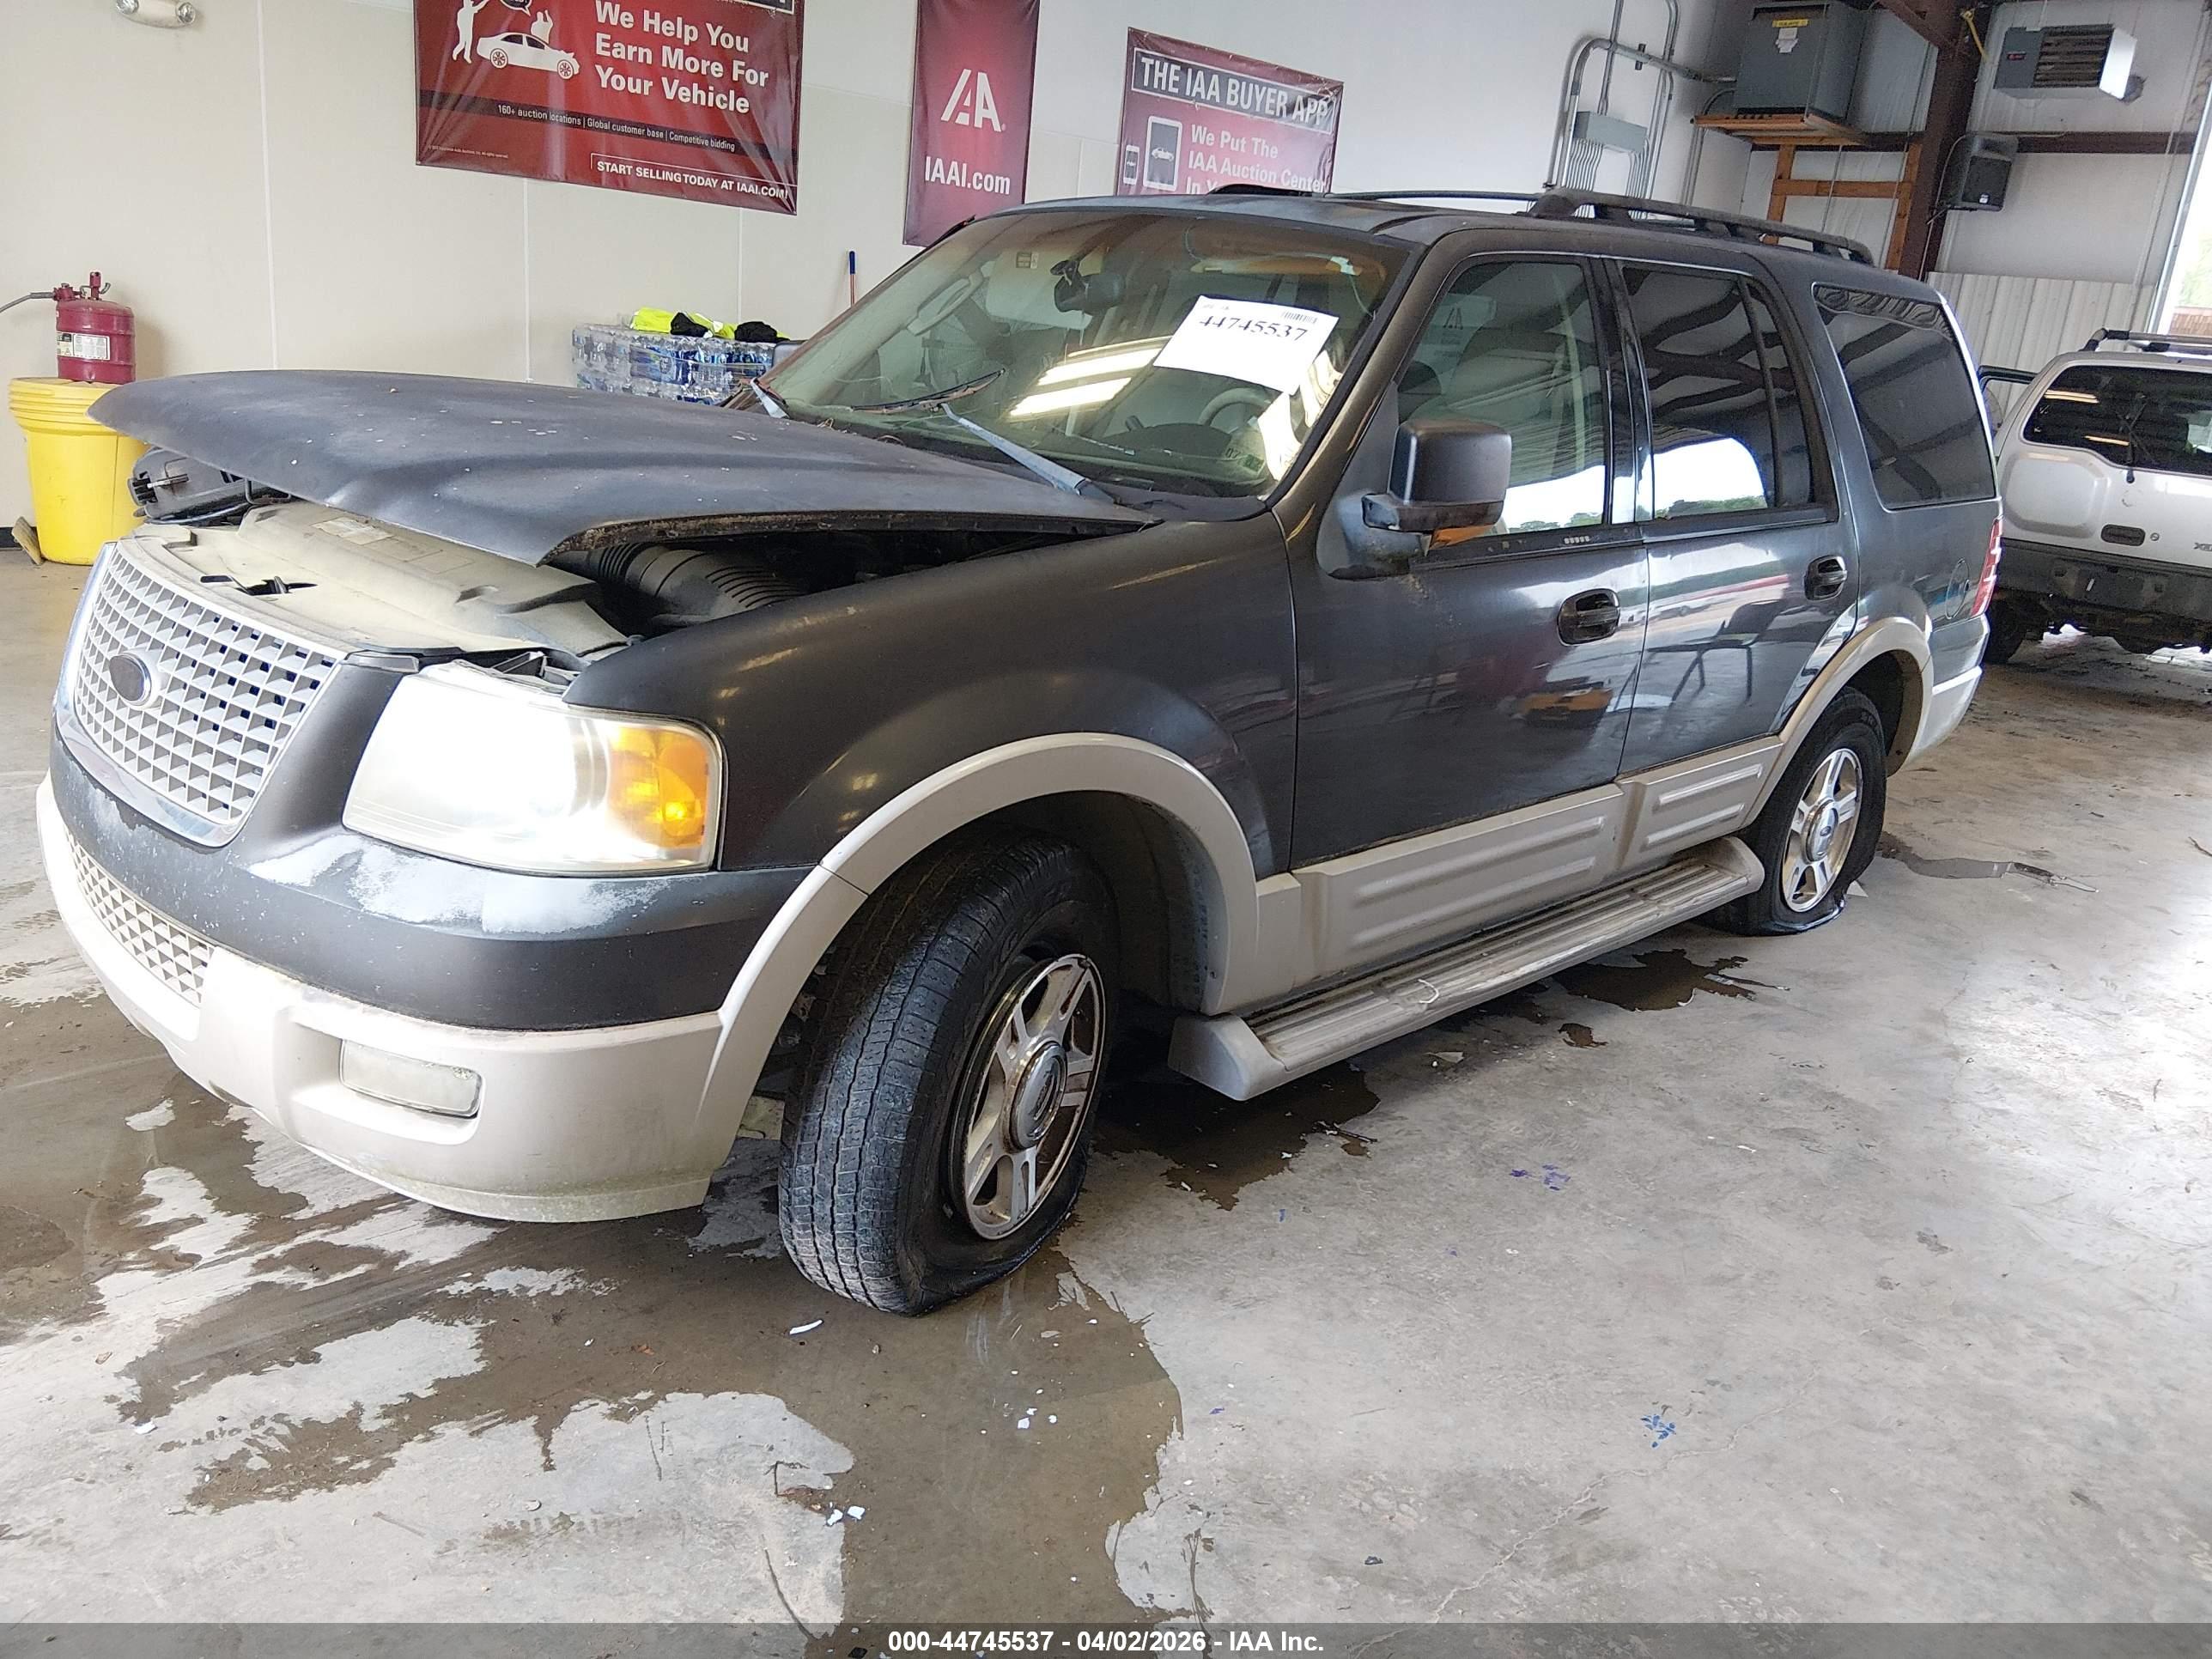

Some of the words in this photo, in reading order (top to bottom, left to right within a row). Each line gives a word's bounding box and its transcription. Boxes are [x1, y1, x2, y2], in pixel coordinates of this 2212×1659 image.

[595, 0, 634, 28] We
[643, 9, 698, 46] Help
[706, 22, 748, 52] You
[596, 32, 653, 64] Earn
[661, 45, 724, 77] More
[732, 59, 769, 87] For
[595, 64, 653, 94] Your
[661, 76, 750, 113] Vehicle
[1141, 57, 1181, 94] THE
[1185, 68, 1220, 103] IAA
[1227, 77, 1288, 118] BUYER
[1291, 94, 1331, 125] APP
[498, 105, 514, 115] 160+
[518, 109, 548, 120] auction
[550, 112, 581, 125] locations
[586, 118, 610, 130] Global
[612, 123, 646, 135] customer
[647, 127, 664, 138] base
[669, 131, 709, 147] Competitive
[710, 139, 735, 152] bidding
[1191, 124, 1215, 146] We
[1220, 130, 1247, 153] Put
[1251, 137, 1279, 159] The
[597, 161, 633, 175] START
[635, 167, 682, 183] SELLING
[682, 174, 719, 188] TODAY
[720, 180, 734, 190] AT
[737, 182, 789, 198] IAAI.COM!
[925, 155, 1011, 195] IAAI.com
[1188, 150, 1218, 173] IAA
[1220, 157, 1277, 184] Auction
[1280, 168, 1327, 192] Center
[1200, 316, 1308, 341] 44745537
